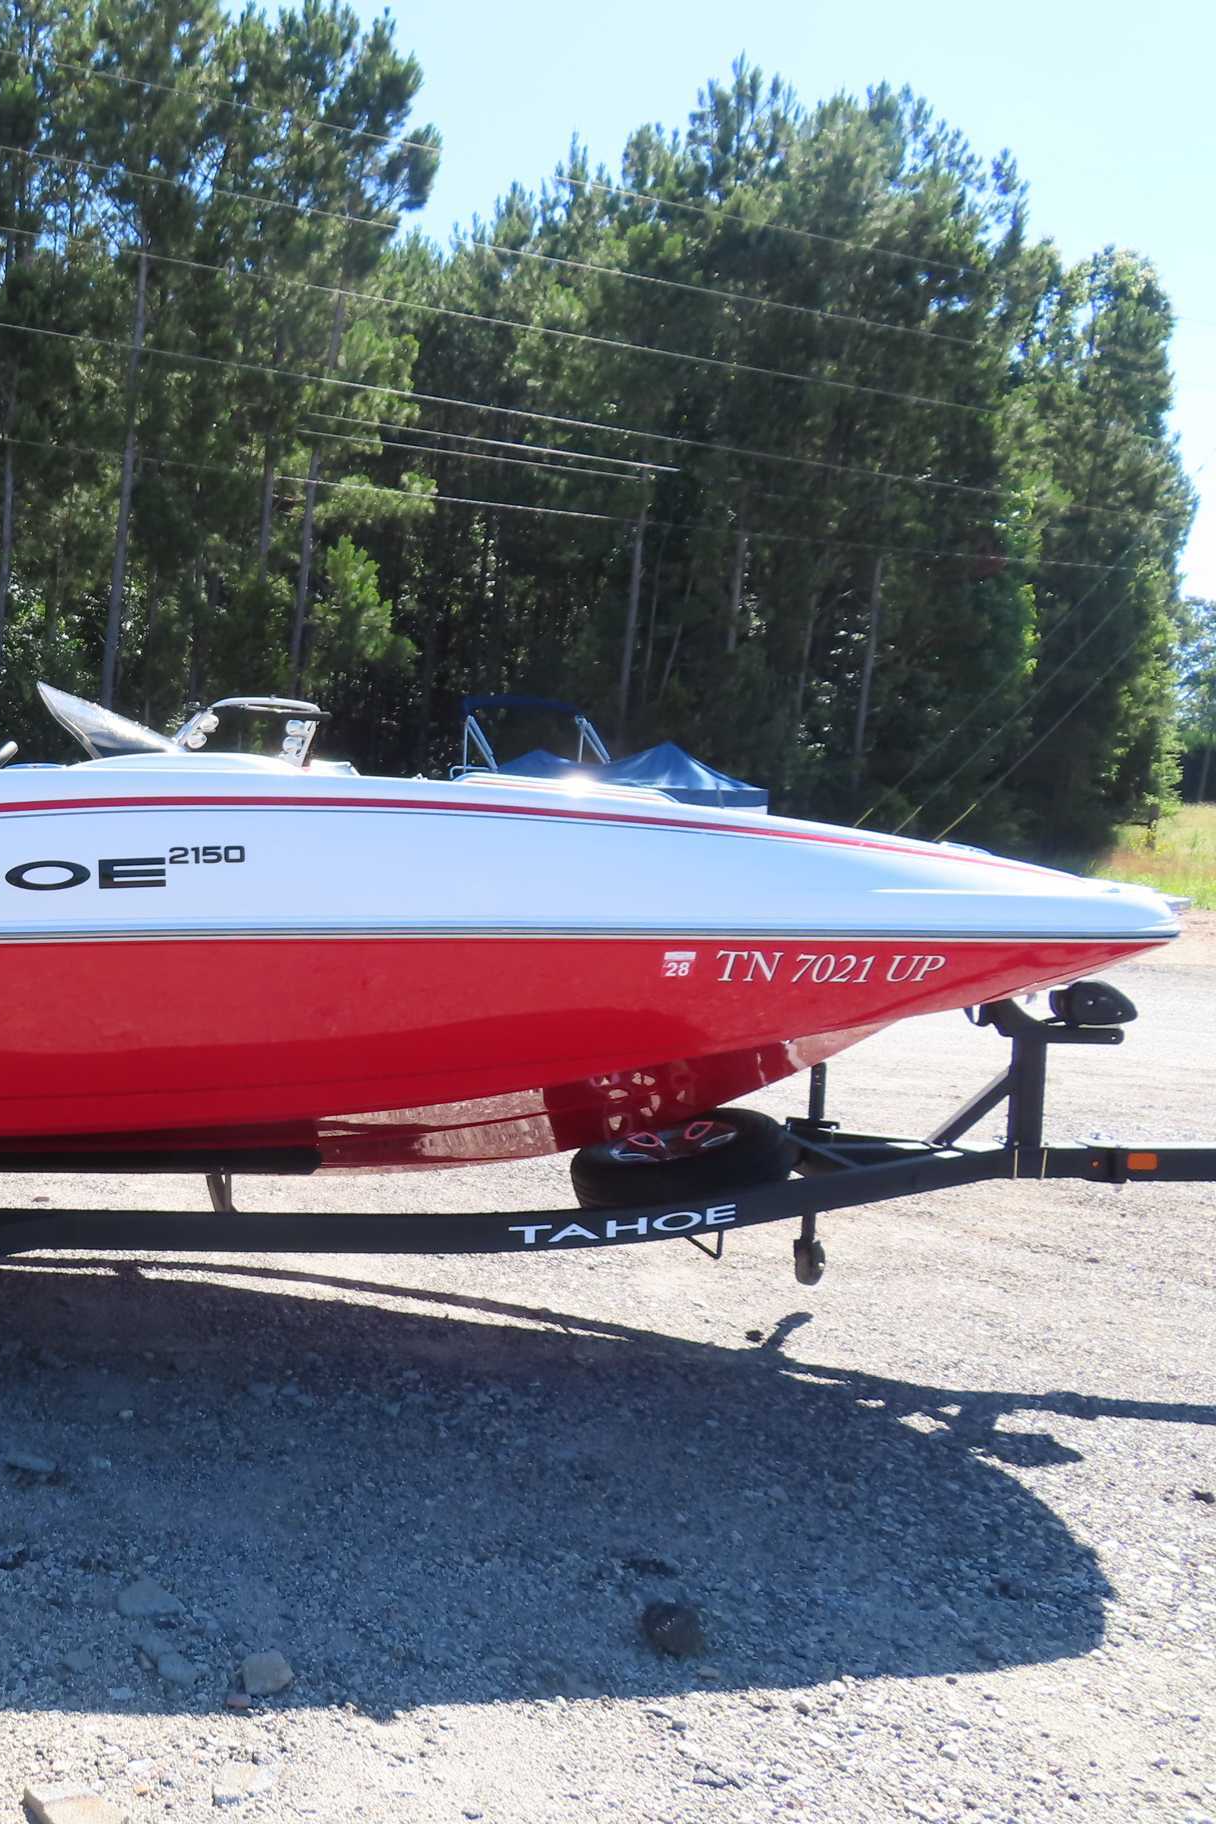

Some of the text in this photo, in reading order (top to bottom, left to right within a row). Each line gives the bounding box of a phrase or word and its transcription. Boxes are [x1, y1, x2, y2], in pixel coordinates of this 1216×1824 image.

[169, 845, 245, 864] 2150
[664, 962, 690, 977] 28
[716, 950, 946, 983] TN 7021 UP
[508, 1204, 737, 1244] TAHOE
